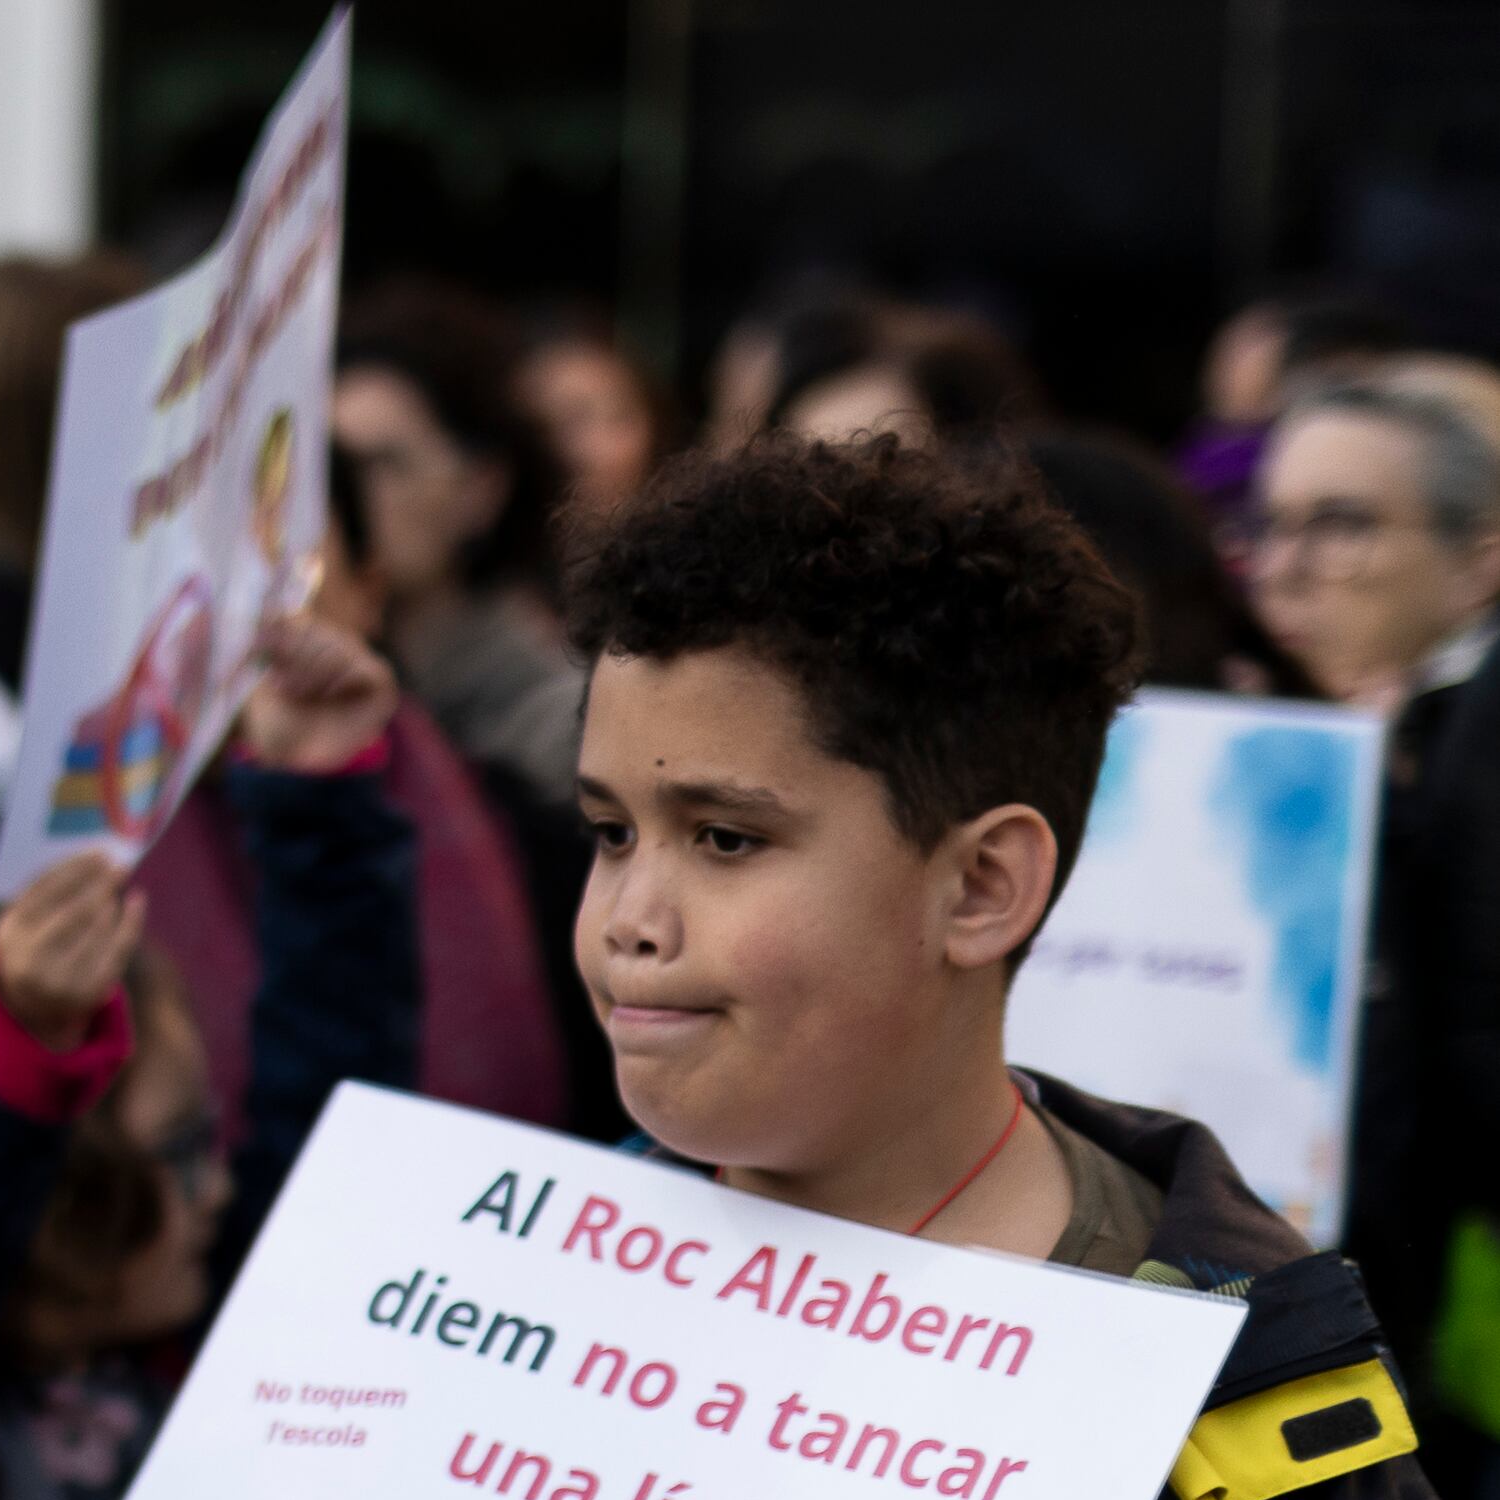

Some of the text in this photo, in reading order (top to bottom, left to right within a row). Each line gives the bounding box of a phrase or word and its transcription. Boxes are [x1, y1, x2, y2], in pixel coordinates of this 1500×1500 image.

[368, 1270, 556, 1372] diem
[573, 1342, 677, 1410] no
[695, 1382, 746, 1434] a
[462, 1171, 1033, 1376] Al Roc Alabern
[251, 1379, 409, 1413] No toquem
